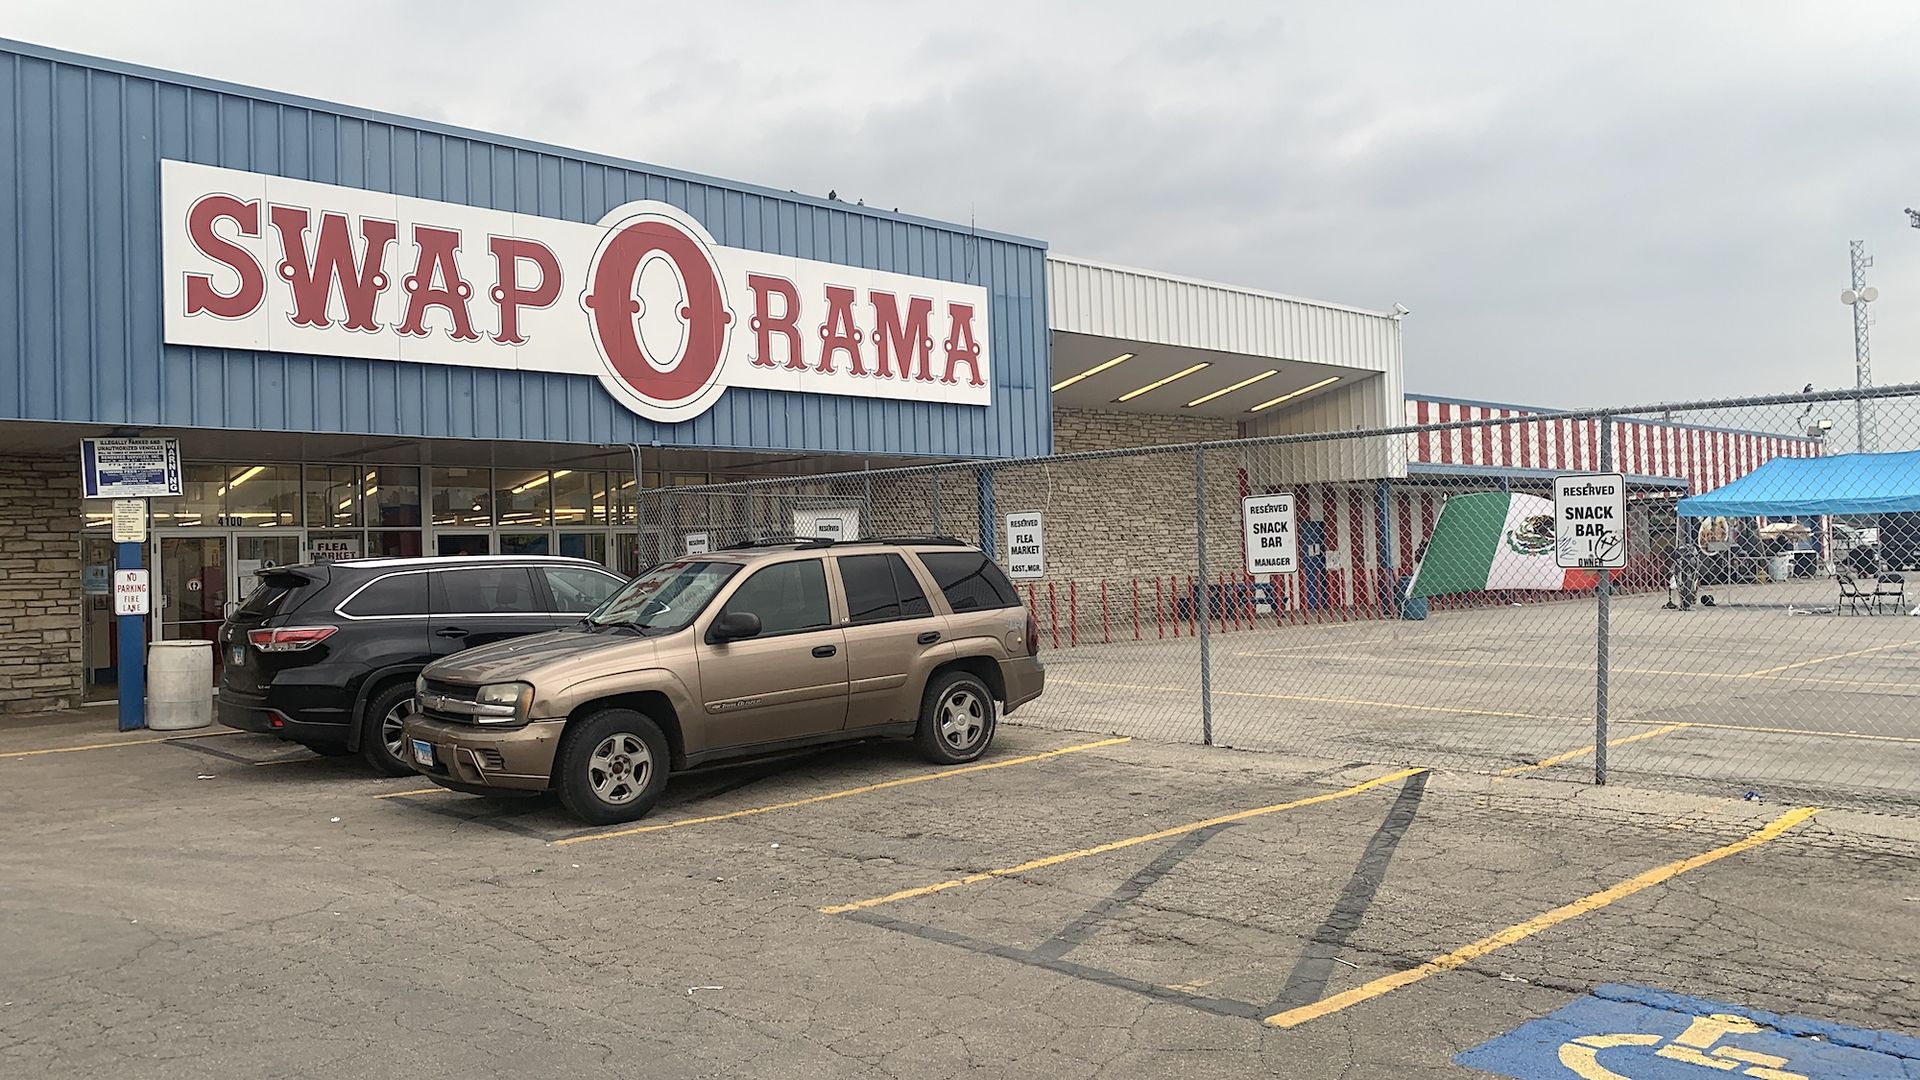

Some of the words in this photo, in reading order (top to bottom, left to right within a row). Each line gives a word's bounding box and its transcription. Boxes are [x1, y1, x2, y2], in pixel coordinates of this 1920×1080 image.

[184, 194, 563, 346] SWAP
[581, 219, 735, 405] O
[747, 272, 990, 388] RAMA
[166, 441, 178, 491] WARNING
[1563, 486, 1615, 496] RESERVED
[1250, 504, 1288, 514] RESERVED
[1565, 506, 1613, 520] SNACK
[218, 517, 242, 526] 4100
[1253, 522, 1288, 534] SNACK
[1576, 524, 1604, 536] BAR
[1016, 534, 1034, 543] FLEA
[1261, 537, 1282, 548] BAR
[318, 543, 348, 551] FLEA
[1011, 545, 1039, 555] MARKET
[1254, 558, 1291, 566] MANAGER
[126, 573, 137, 582] NO
[117, 584, 146, 593] PARKING
[124, 595, 139, 603] FIRE
[123, 604, 141, 612] LANE
